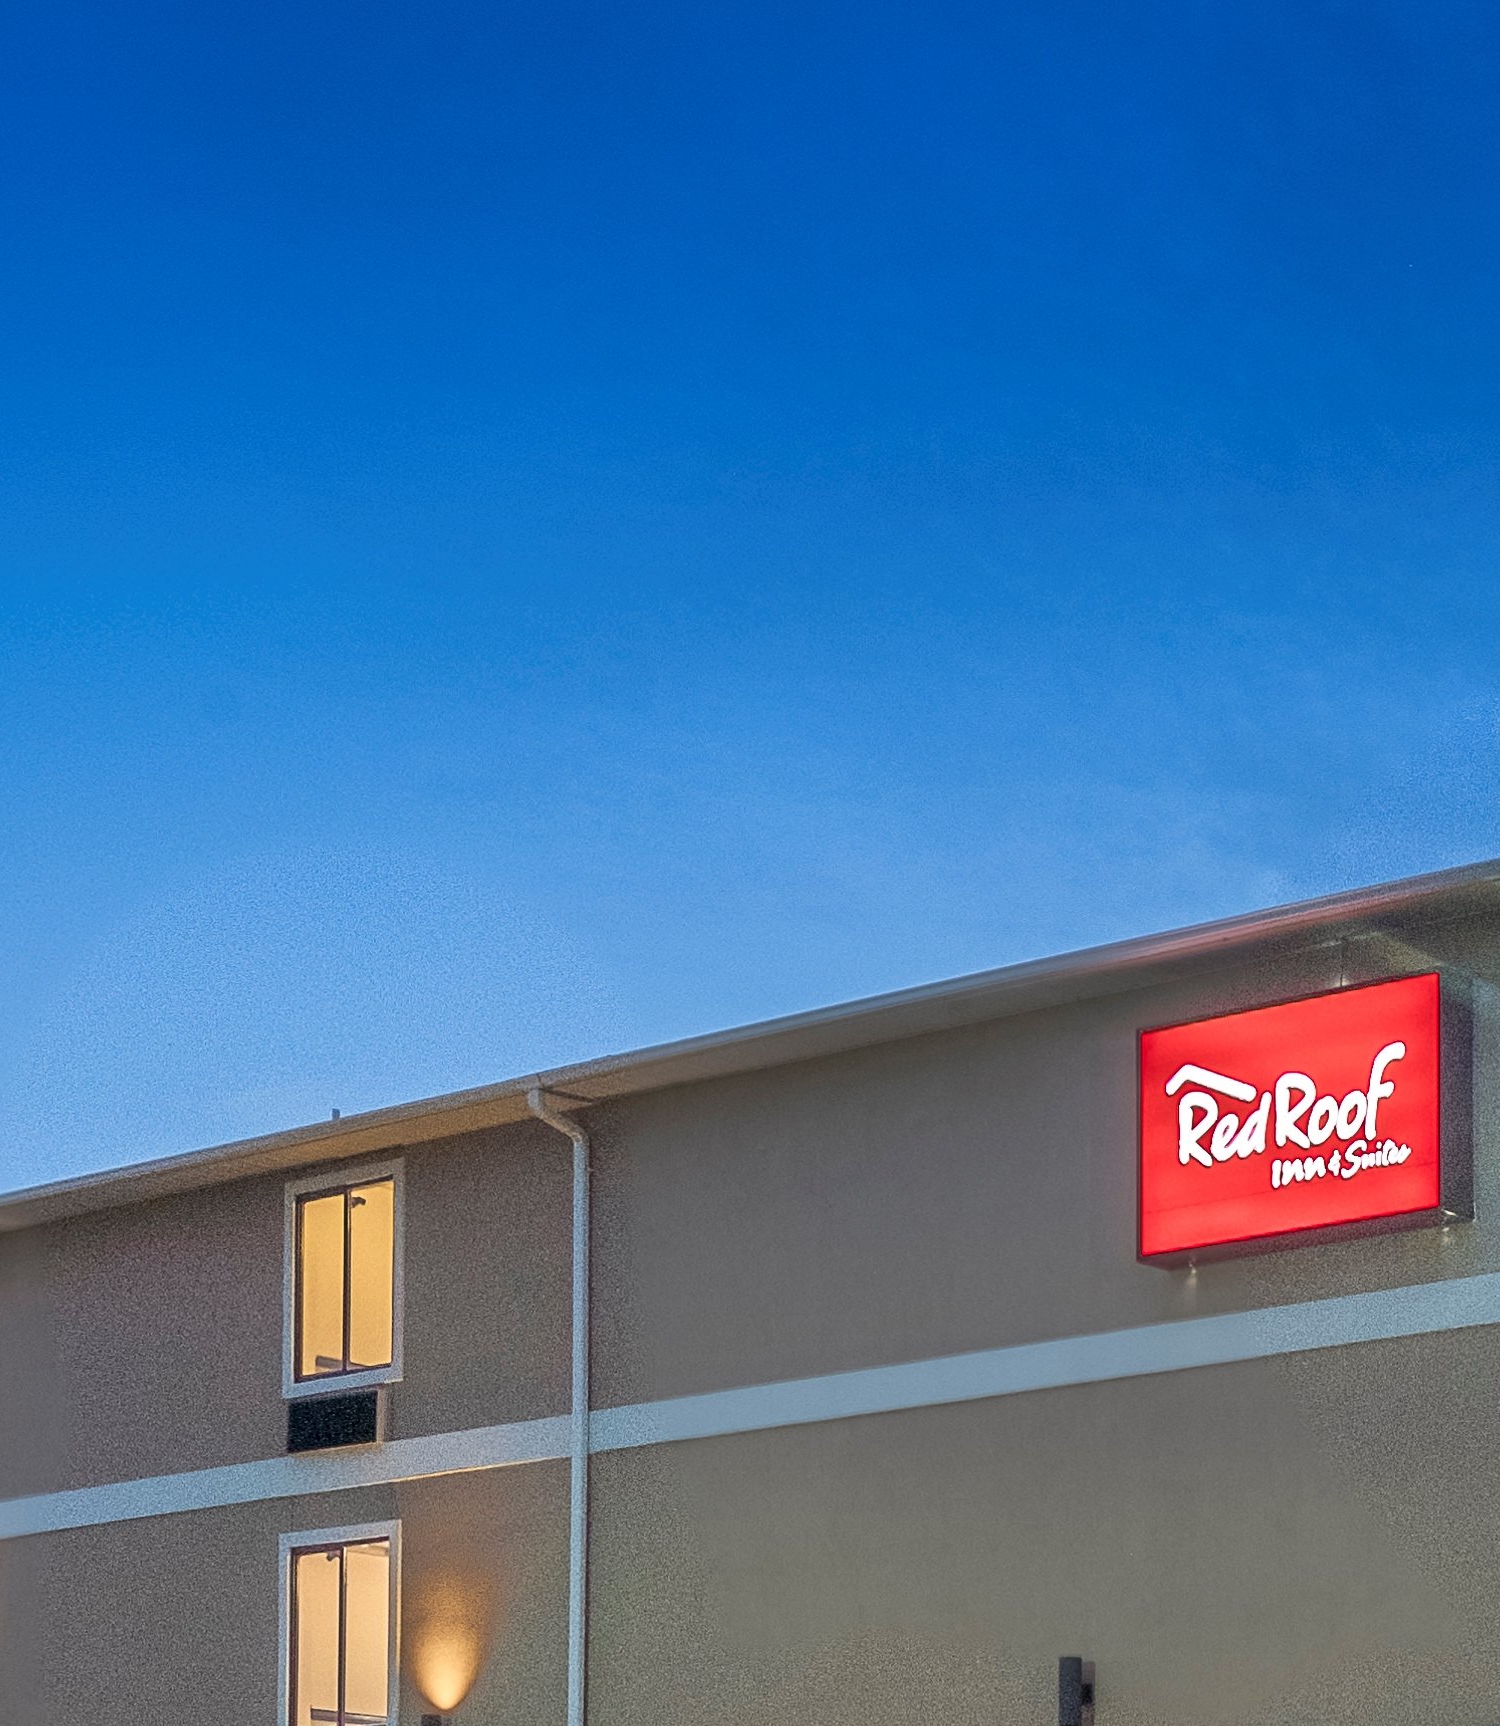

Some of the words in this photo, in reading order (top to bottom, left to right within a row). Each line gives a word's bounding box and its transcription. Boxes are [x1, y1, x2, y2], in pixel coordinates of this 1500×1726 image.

[1178, 1091, 1272, 1167] Red
[1275, 1041, 1406, 1149] Roof
[1271, 1157, 1326, 1189] Inn
[1328, 1149, 1341, 1177] &
[1341, 1139, 1412, 1180] Suites
